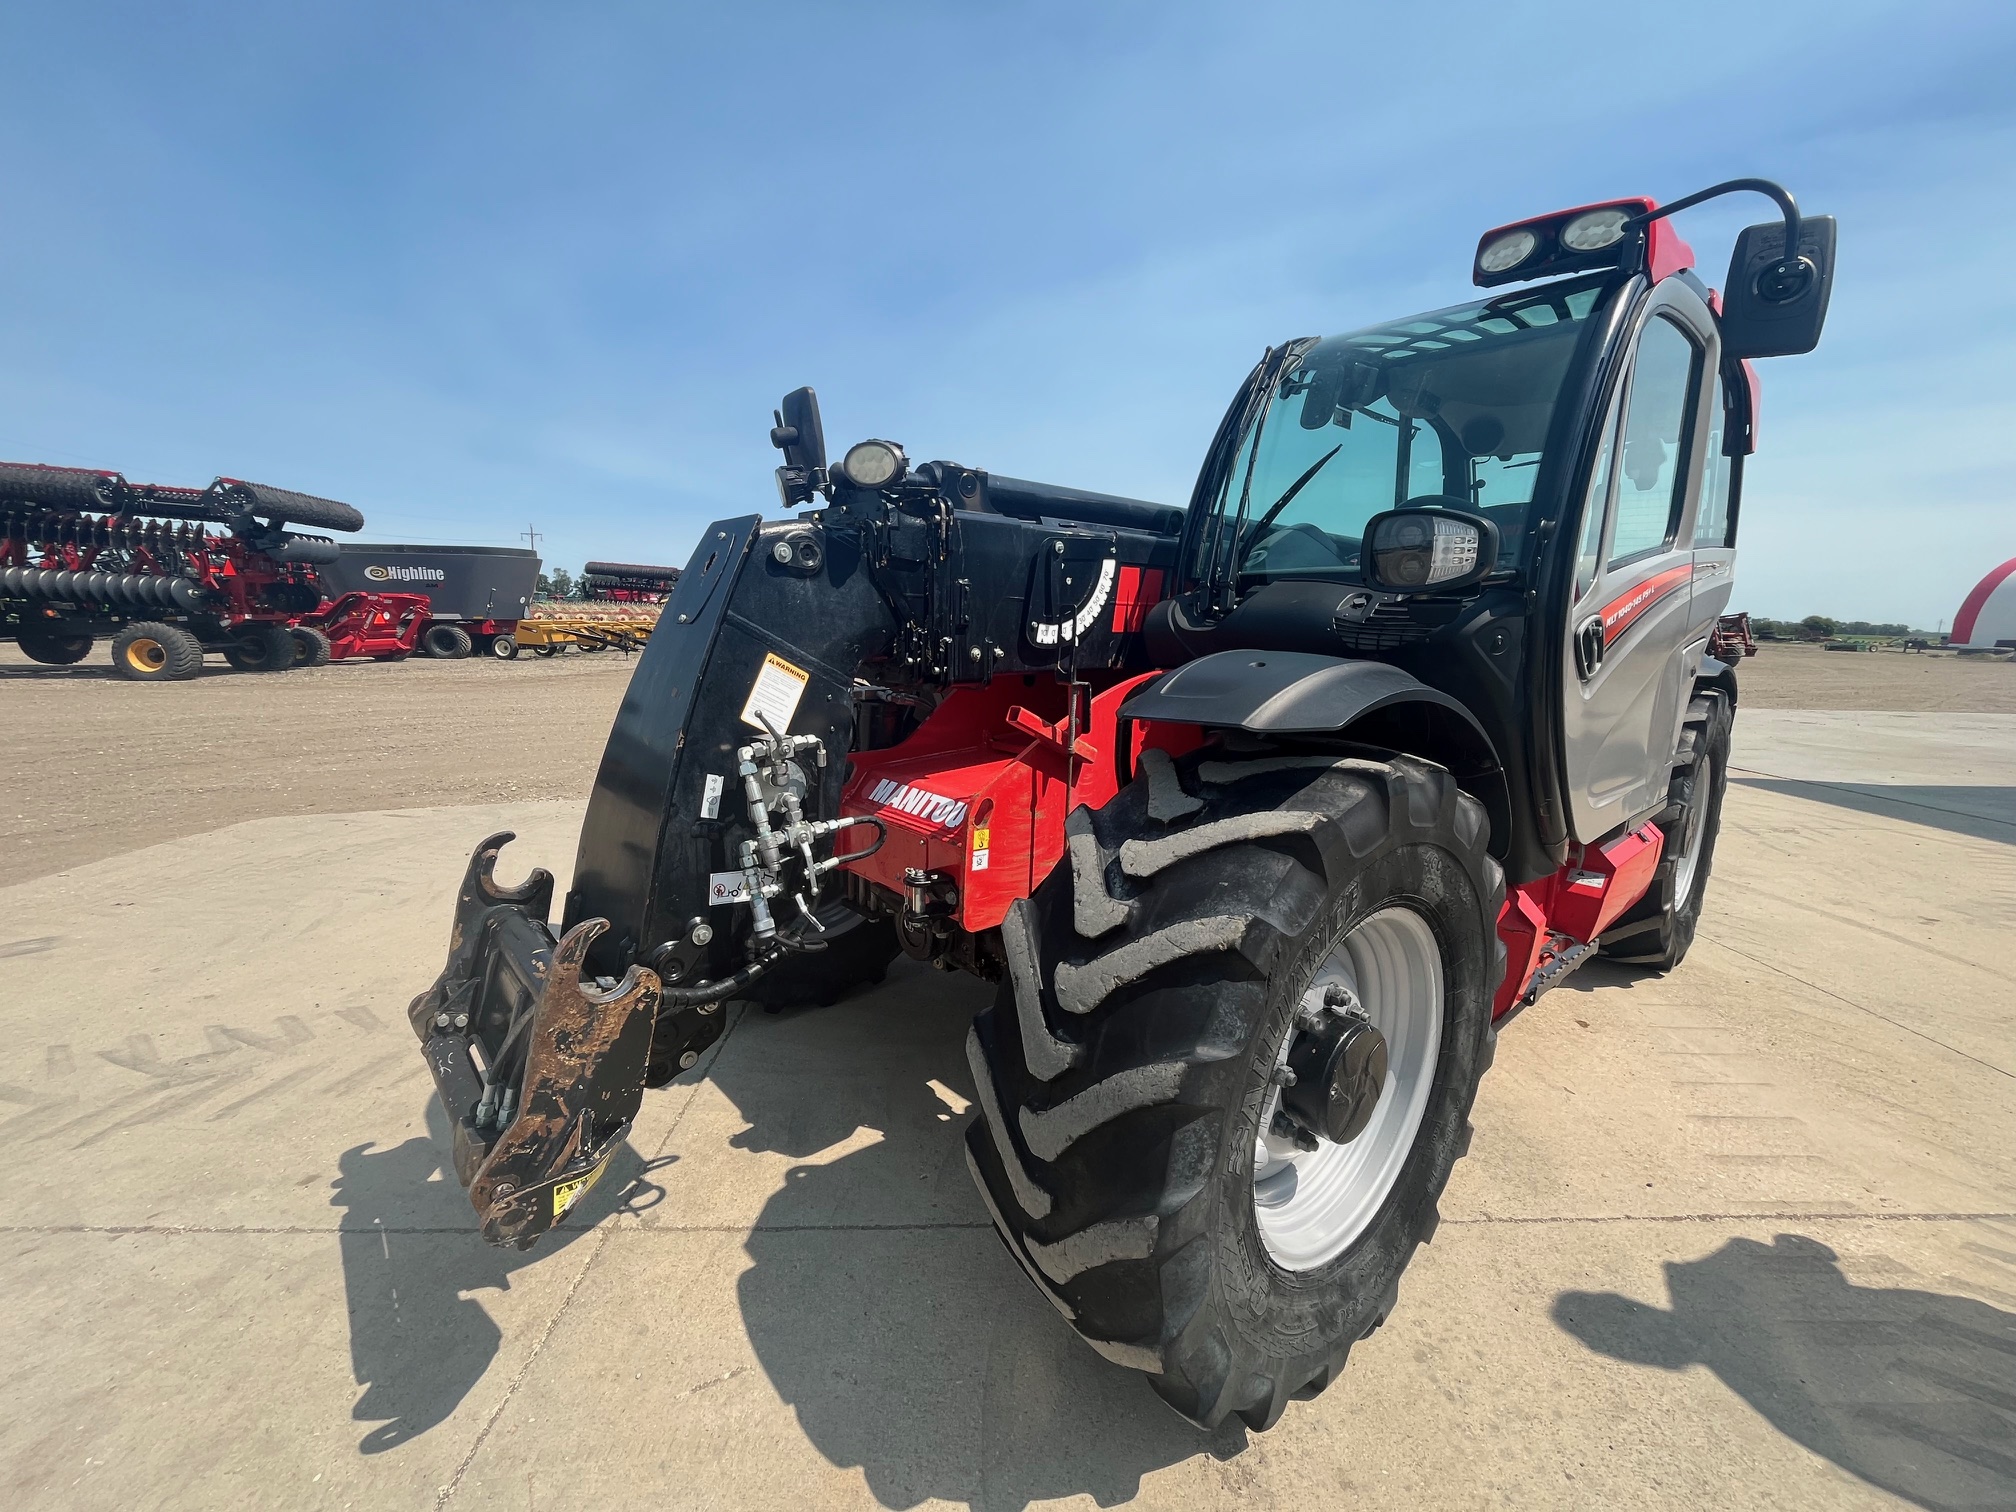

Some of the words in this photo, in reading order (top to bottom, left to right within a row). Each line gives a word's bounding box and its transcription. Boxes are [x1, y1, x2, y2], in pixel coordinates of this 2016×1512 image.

[387, 566, 445, 582] Highline
[775, 660, 806, 681] WARNING
[868, 778, 968, 828] MANITOU
